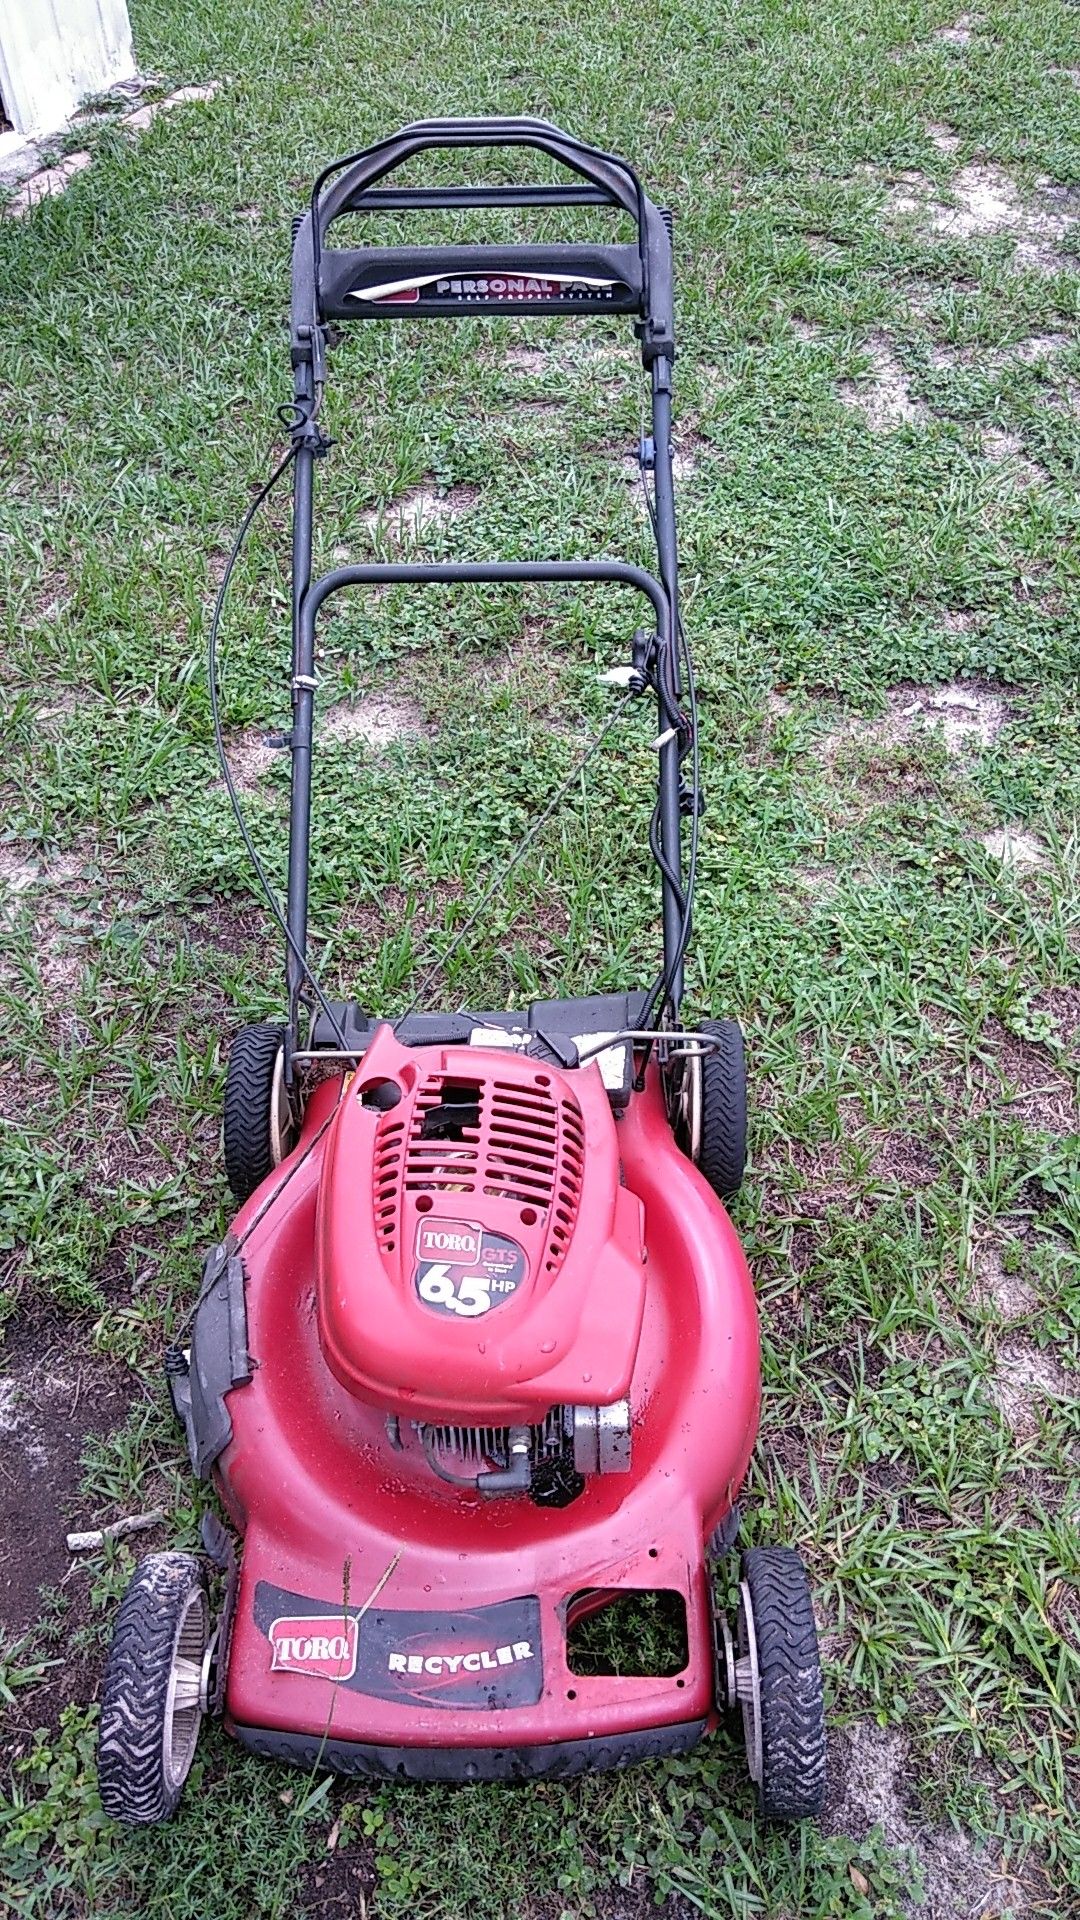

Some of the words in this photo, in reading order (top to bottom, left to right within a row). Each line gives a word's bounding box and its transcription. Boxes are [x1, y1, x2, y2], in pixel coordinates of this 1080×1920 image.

[437, 280, 552, 294] PERSONAL
[423, 1231, 475, 1252] TORO
[481, 1247, 518, 1264] GTS
[491, 1279, 516, 1293] HP
[276, 1636, 350, 1661] TORO
[388, 1641, 534, 1674] RECYCLER
